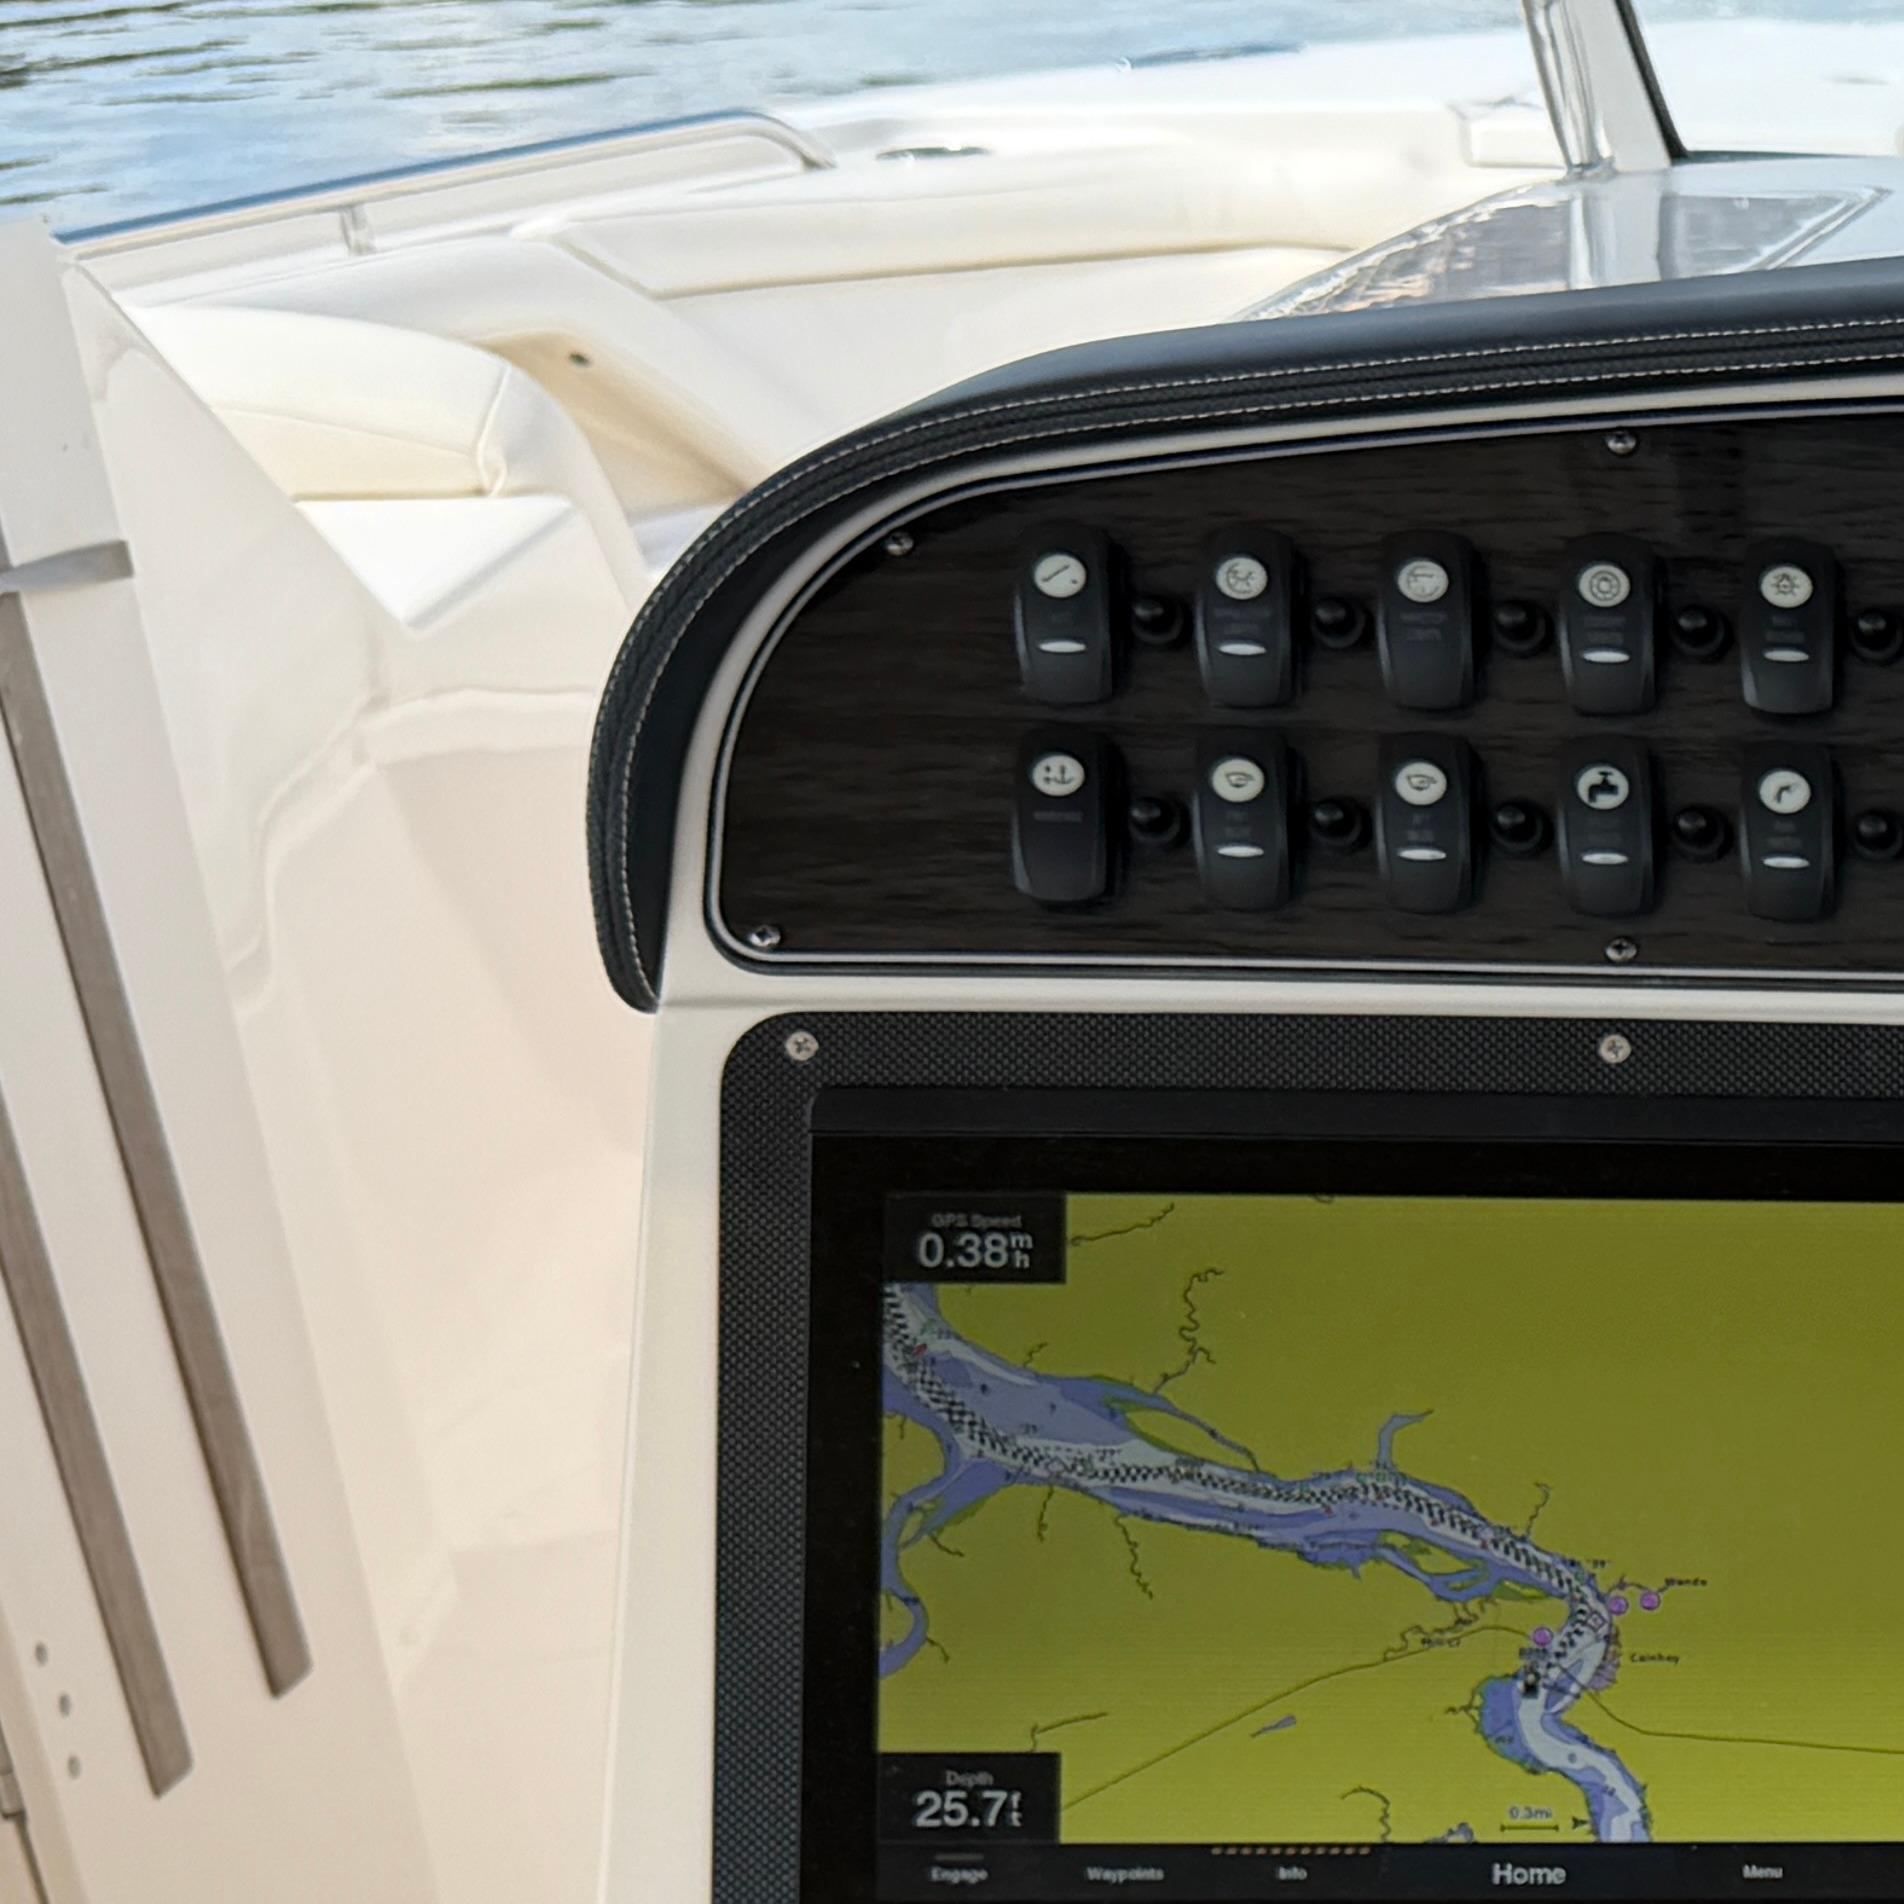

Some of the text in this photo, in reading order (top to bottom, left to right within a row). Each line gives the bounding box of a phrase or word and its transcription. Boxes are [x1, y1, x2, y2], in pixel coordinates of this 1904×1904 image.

[917, 1232, 1008, 1269] 0.38
[946, 1770, 993, 1787] Depth
[915, 1791, 1008, 1828] 25.7
[930, 1866, 988, 1883] Engage
[1087, 1865, 1164, 1882] Waypoints
[1277, 1865, 1307, 1880] Info
[1492, 1863, 1567, 1886] Home
[1742, 1864, 1784, 1880] Menu
